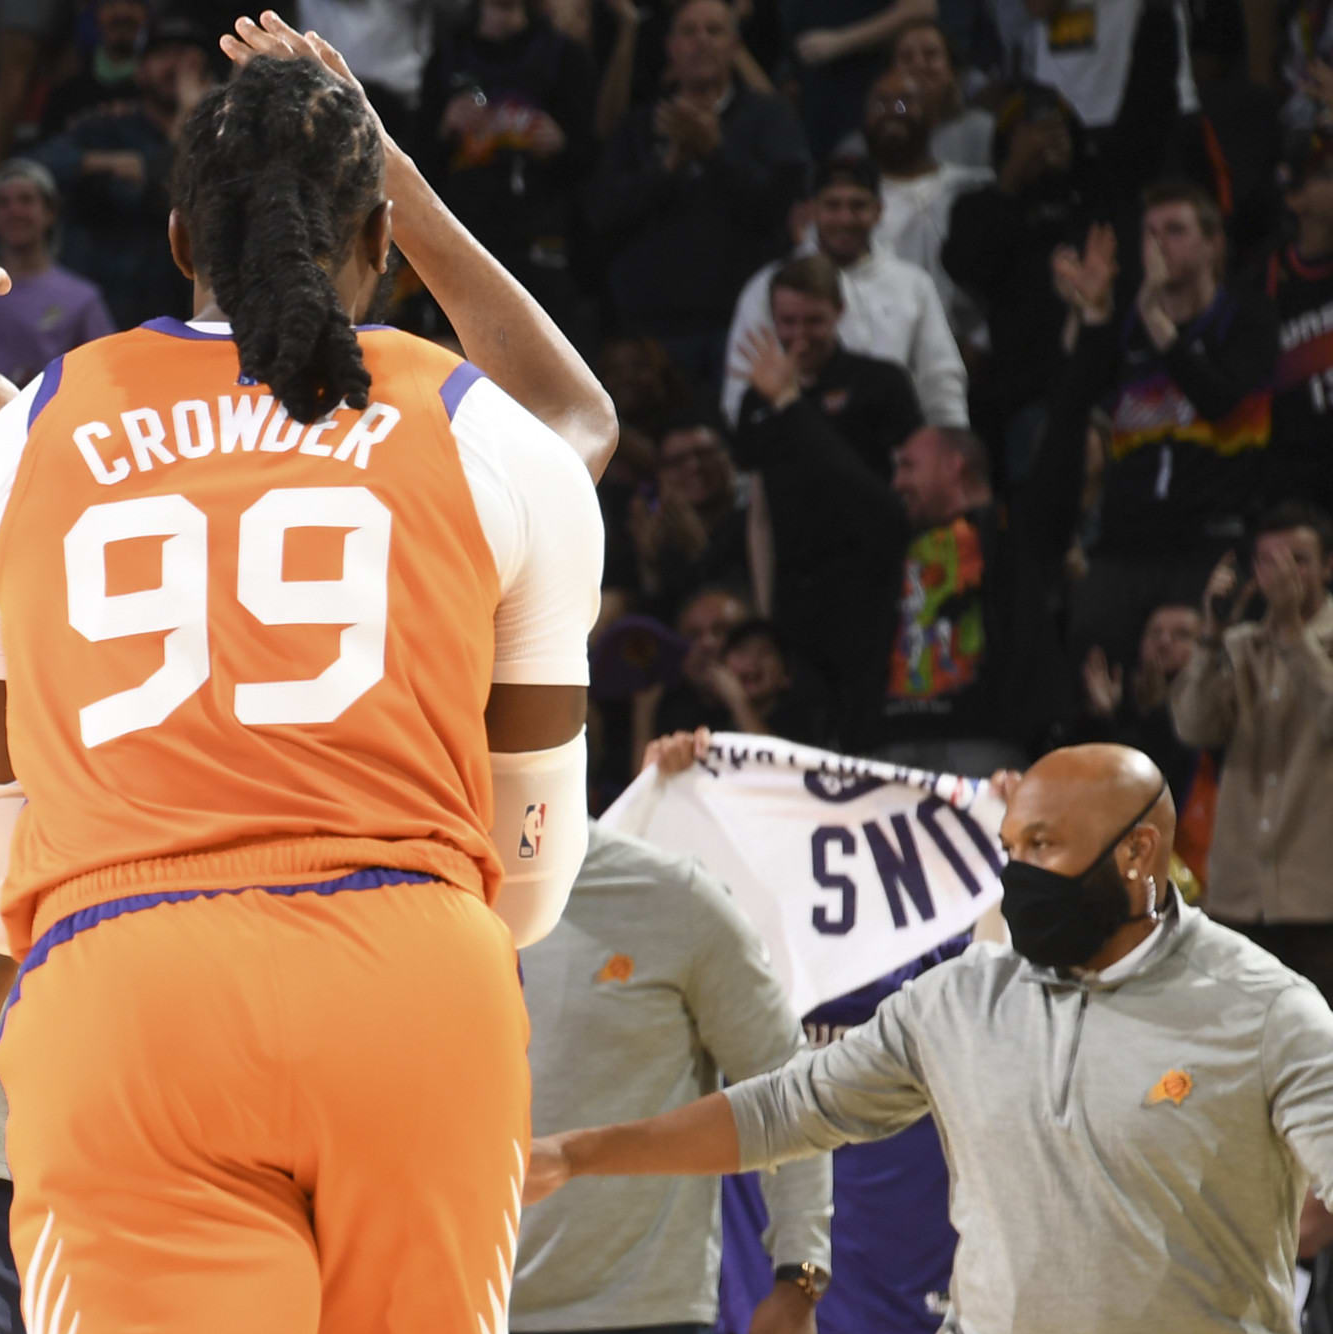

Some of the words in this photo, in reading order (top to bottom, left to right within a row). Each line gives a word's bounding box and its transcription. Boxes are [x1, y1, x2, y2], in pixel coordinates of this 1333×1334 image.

[72, 394, 402, 486] CROWDER
[63, 486, 393, 749] 99
[811, 797, 1005, 935] UNS
